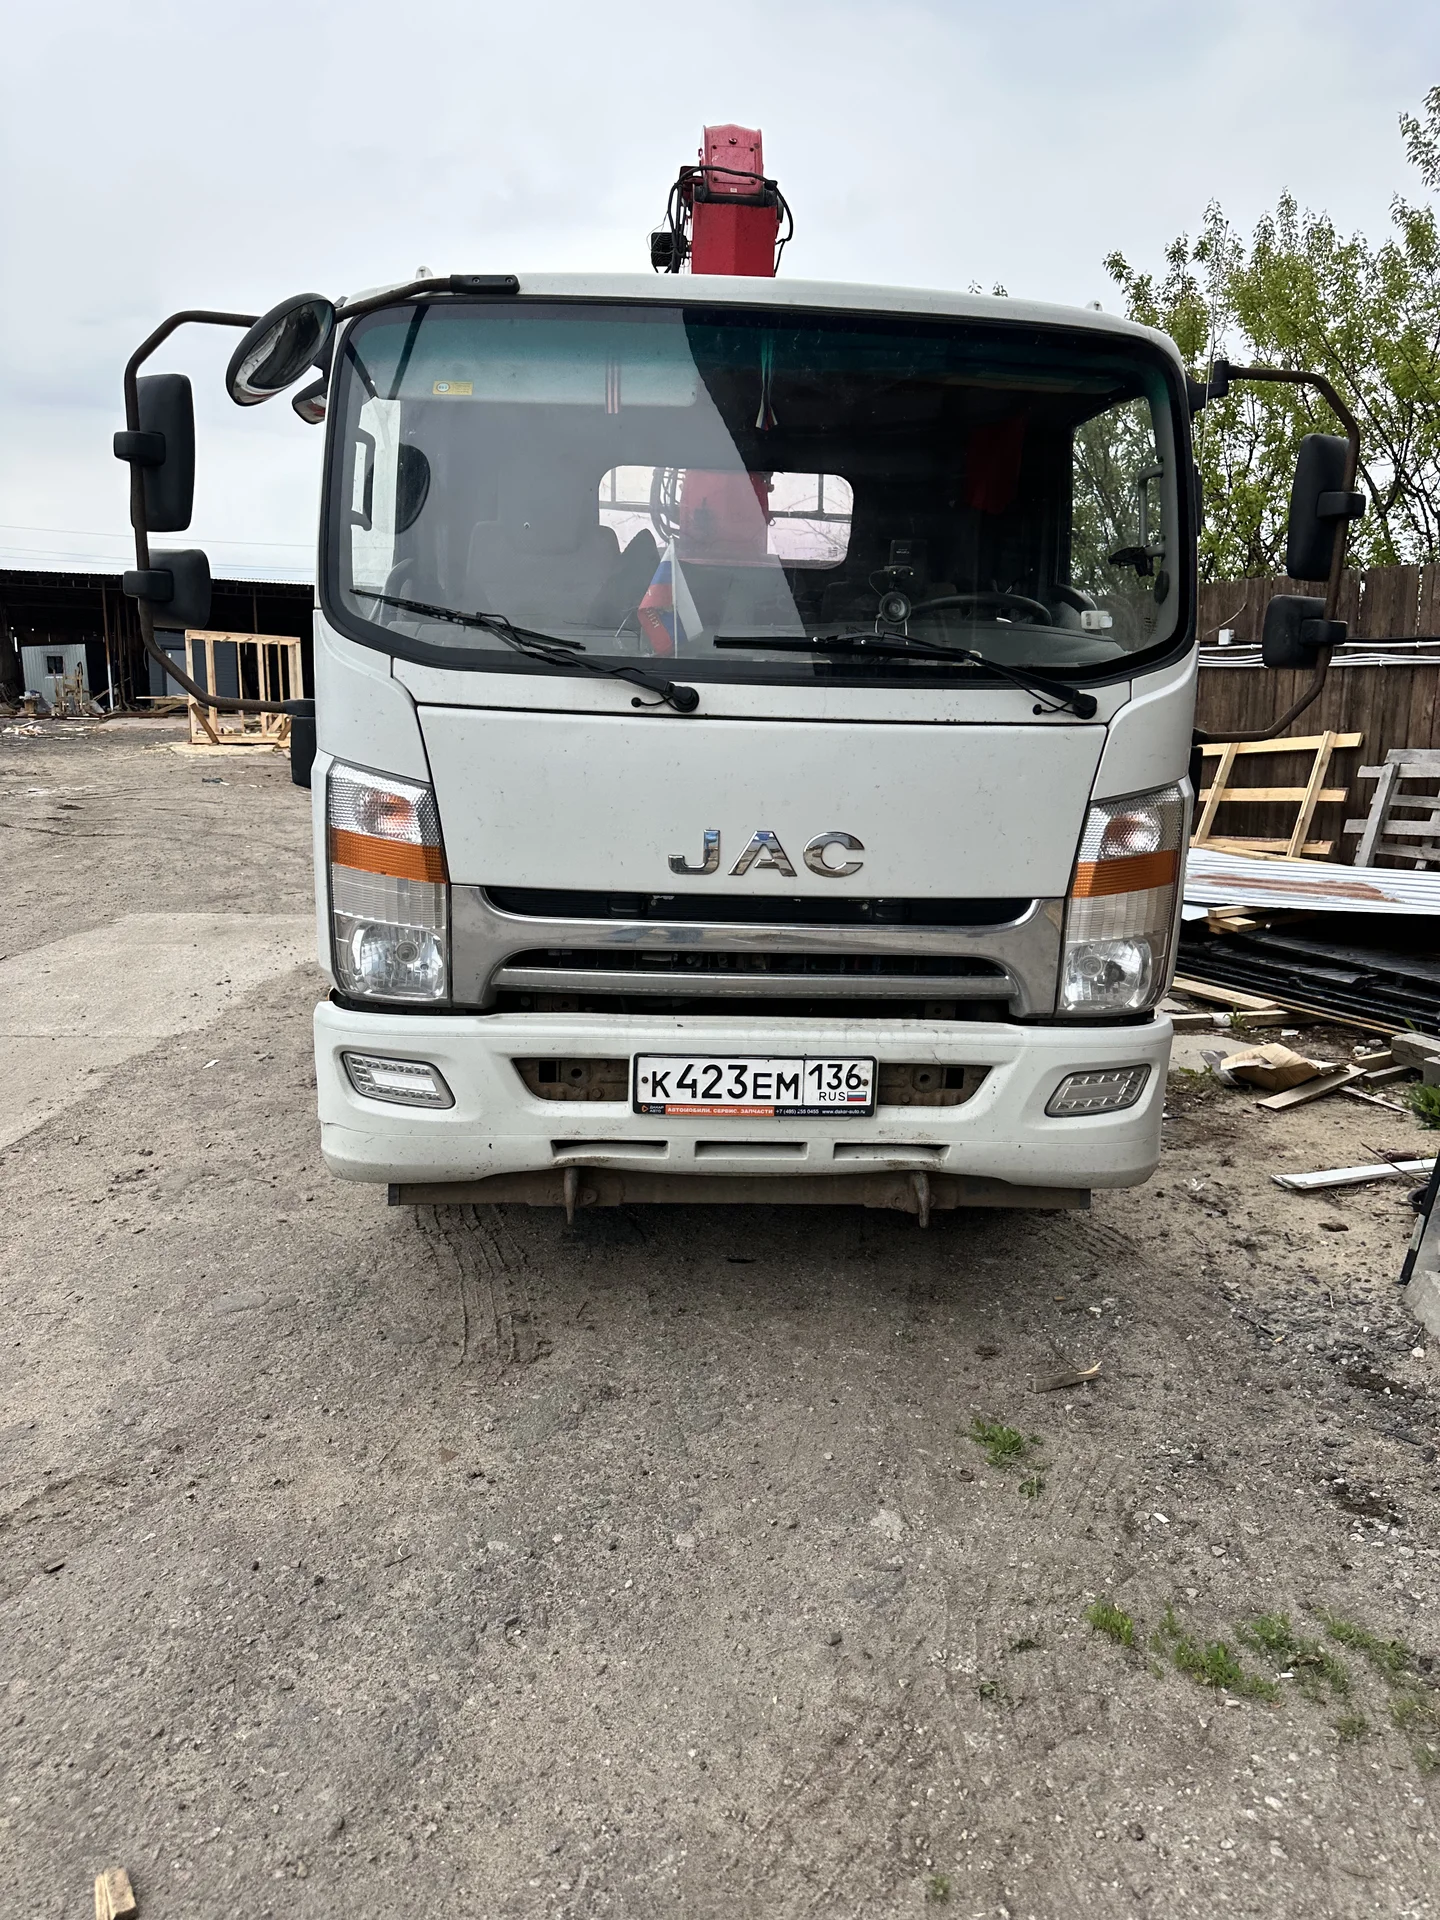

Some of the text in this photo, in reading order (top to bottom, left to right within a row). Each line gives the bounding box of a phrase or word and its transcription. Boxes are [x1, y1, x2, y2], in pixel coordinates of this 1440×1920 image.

[668, 829, 865, 878] JAC
[808, 1064, 862, 1091] 136
[819, 1091, 846, 1102] RUS
